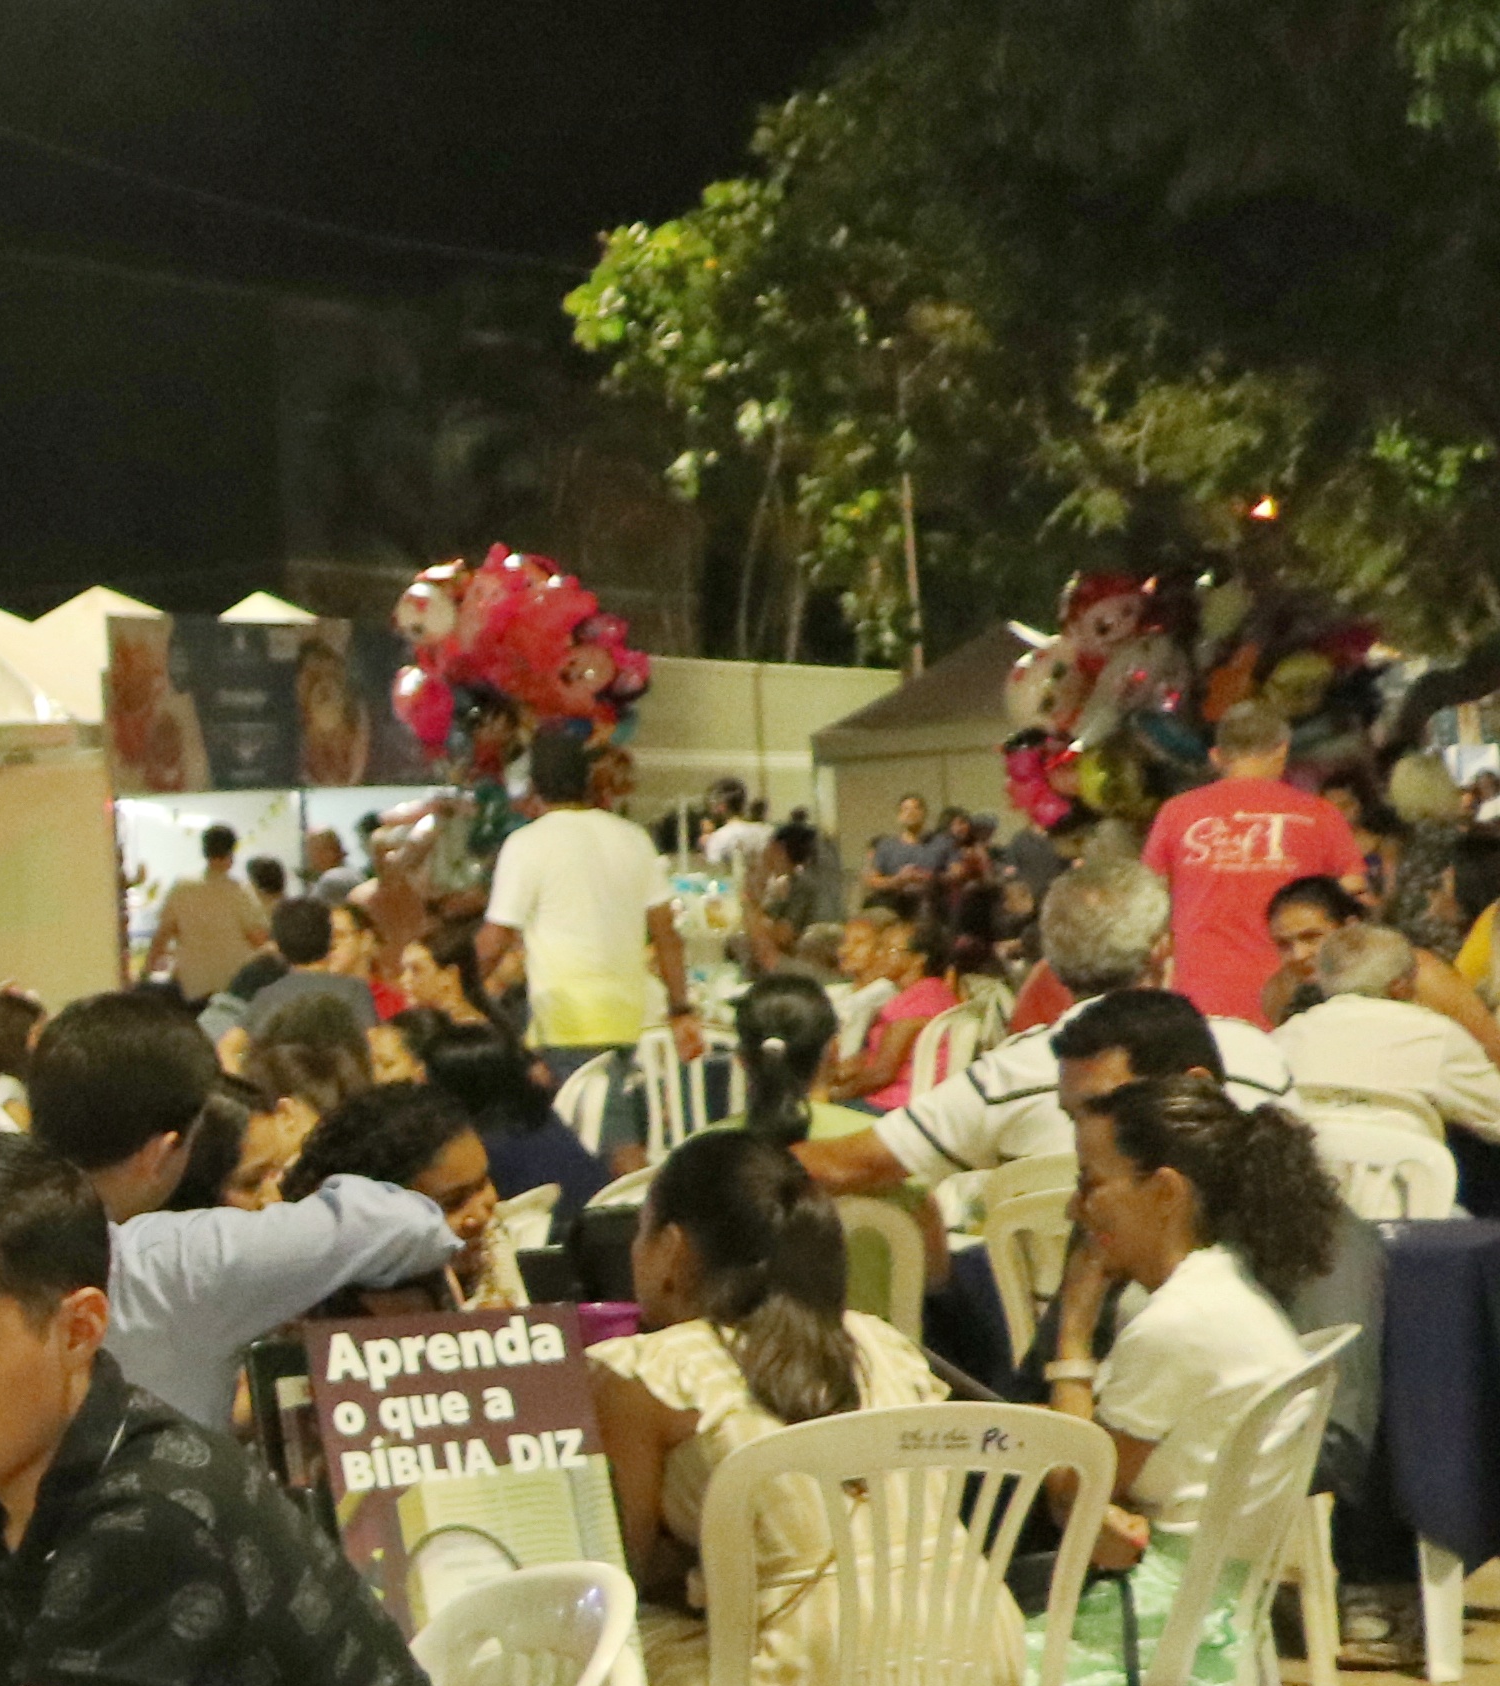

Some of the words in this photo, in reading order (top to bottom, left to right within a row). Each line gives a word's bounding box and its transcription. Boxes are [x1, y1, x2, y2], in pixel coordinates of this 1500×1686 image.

[326, 1314, 566, 1391] Aprenda
[333, 1399, 367, 1436] o
[378, 1390, 471, 1440] que
[481, 1386, 516, 1421] a
[340, 1434, 499, 1493] BÍBLIA
[507, 1427, 588, 1474] DIZ
